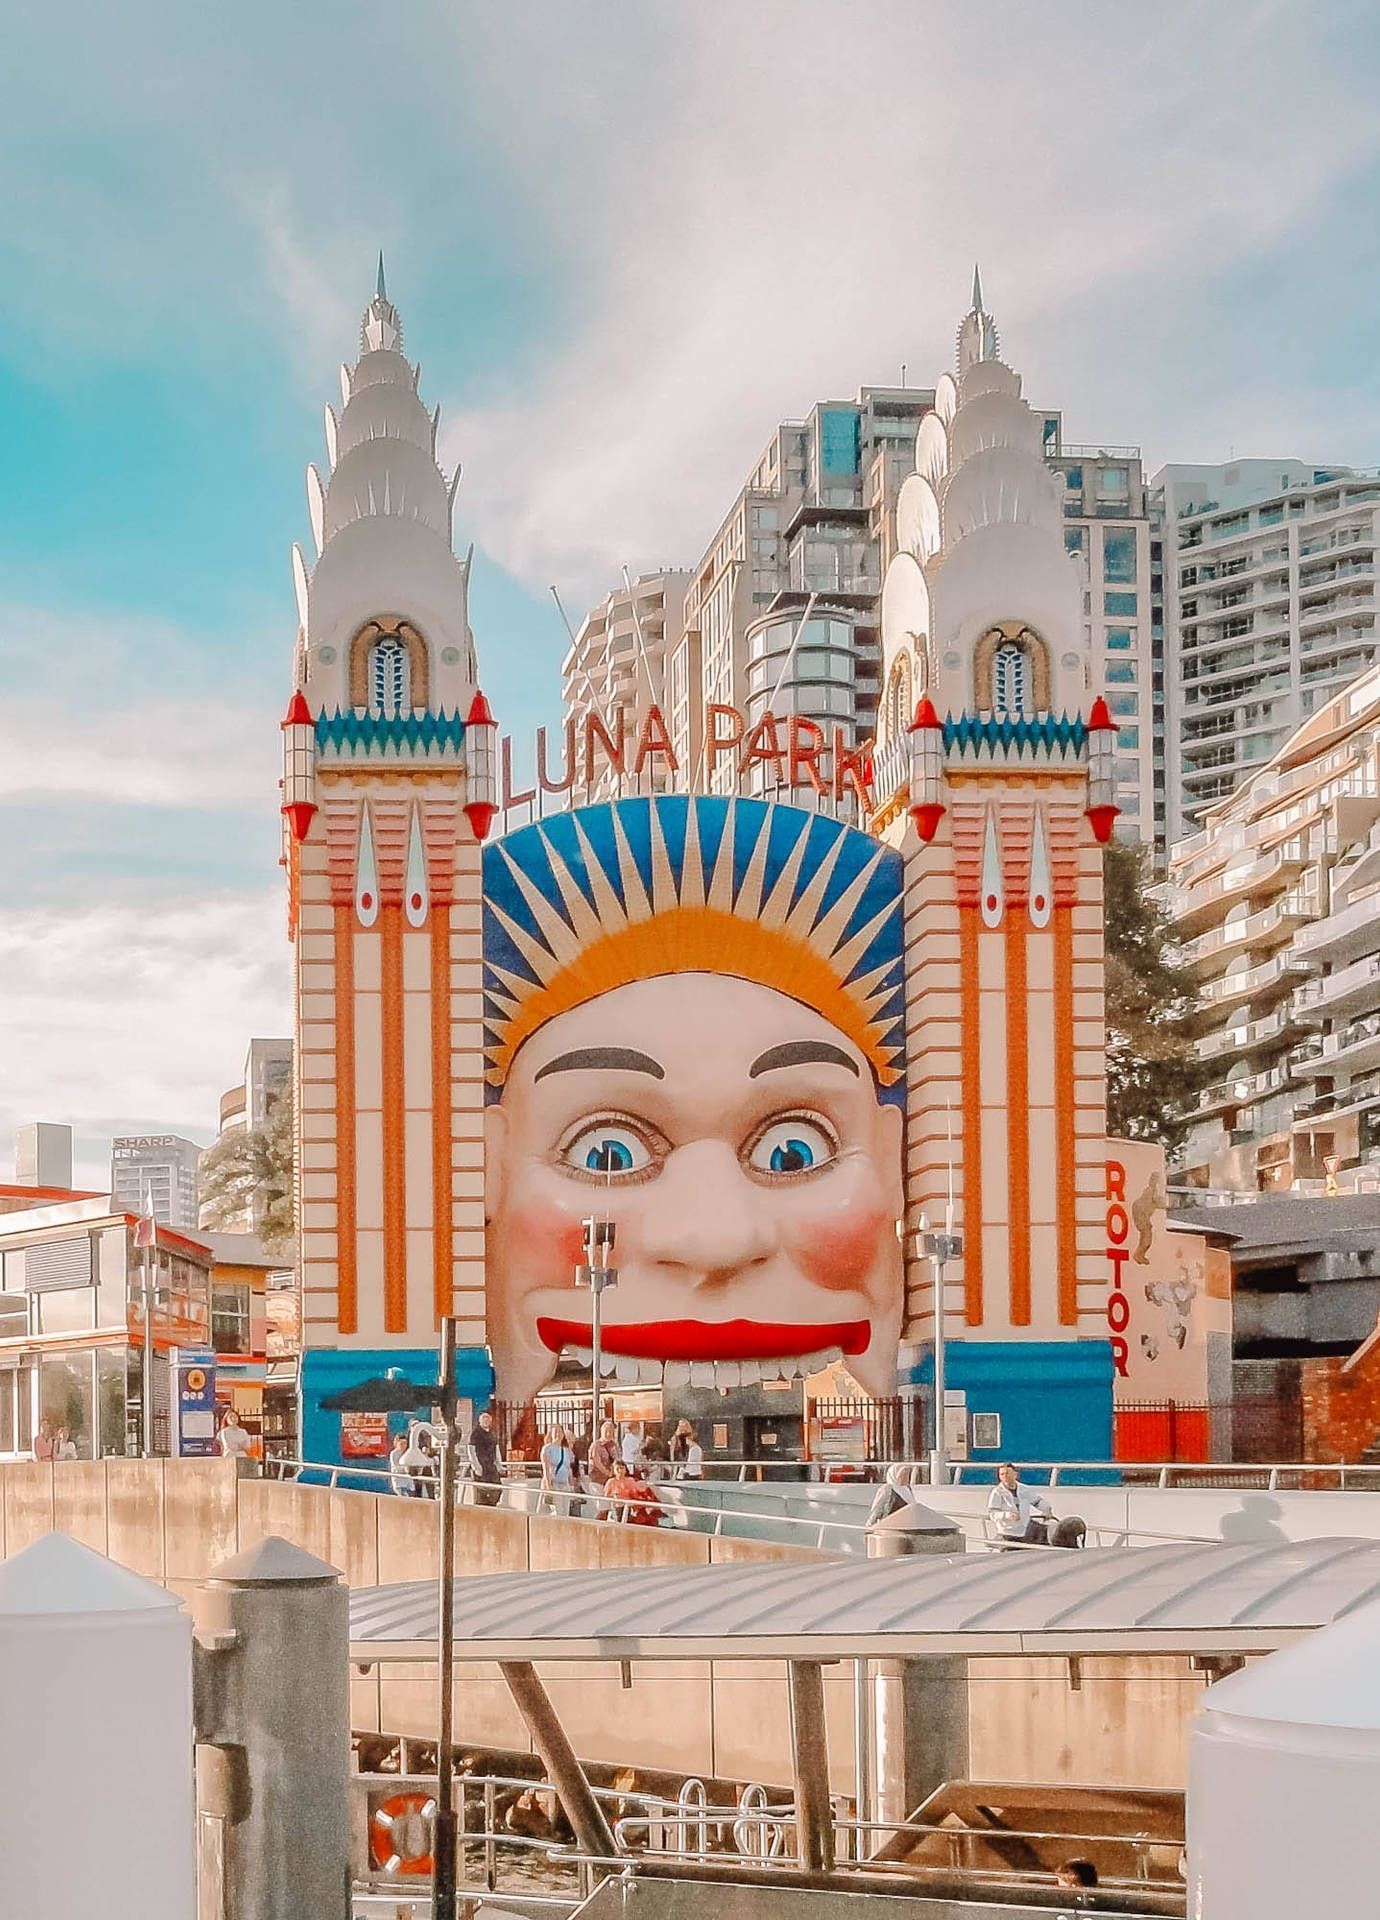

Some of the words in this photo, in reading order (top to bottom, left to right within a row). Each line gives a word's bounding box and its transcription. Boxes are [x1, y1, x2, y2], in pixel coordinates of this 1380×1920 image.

[502, 703, 679, 808] LUNA
[708, 703, 875, 814] PARK
[113, 1136, 174, 1149] SHARP
[1106, 1160, 1129, 1377] ROTOR
